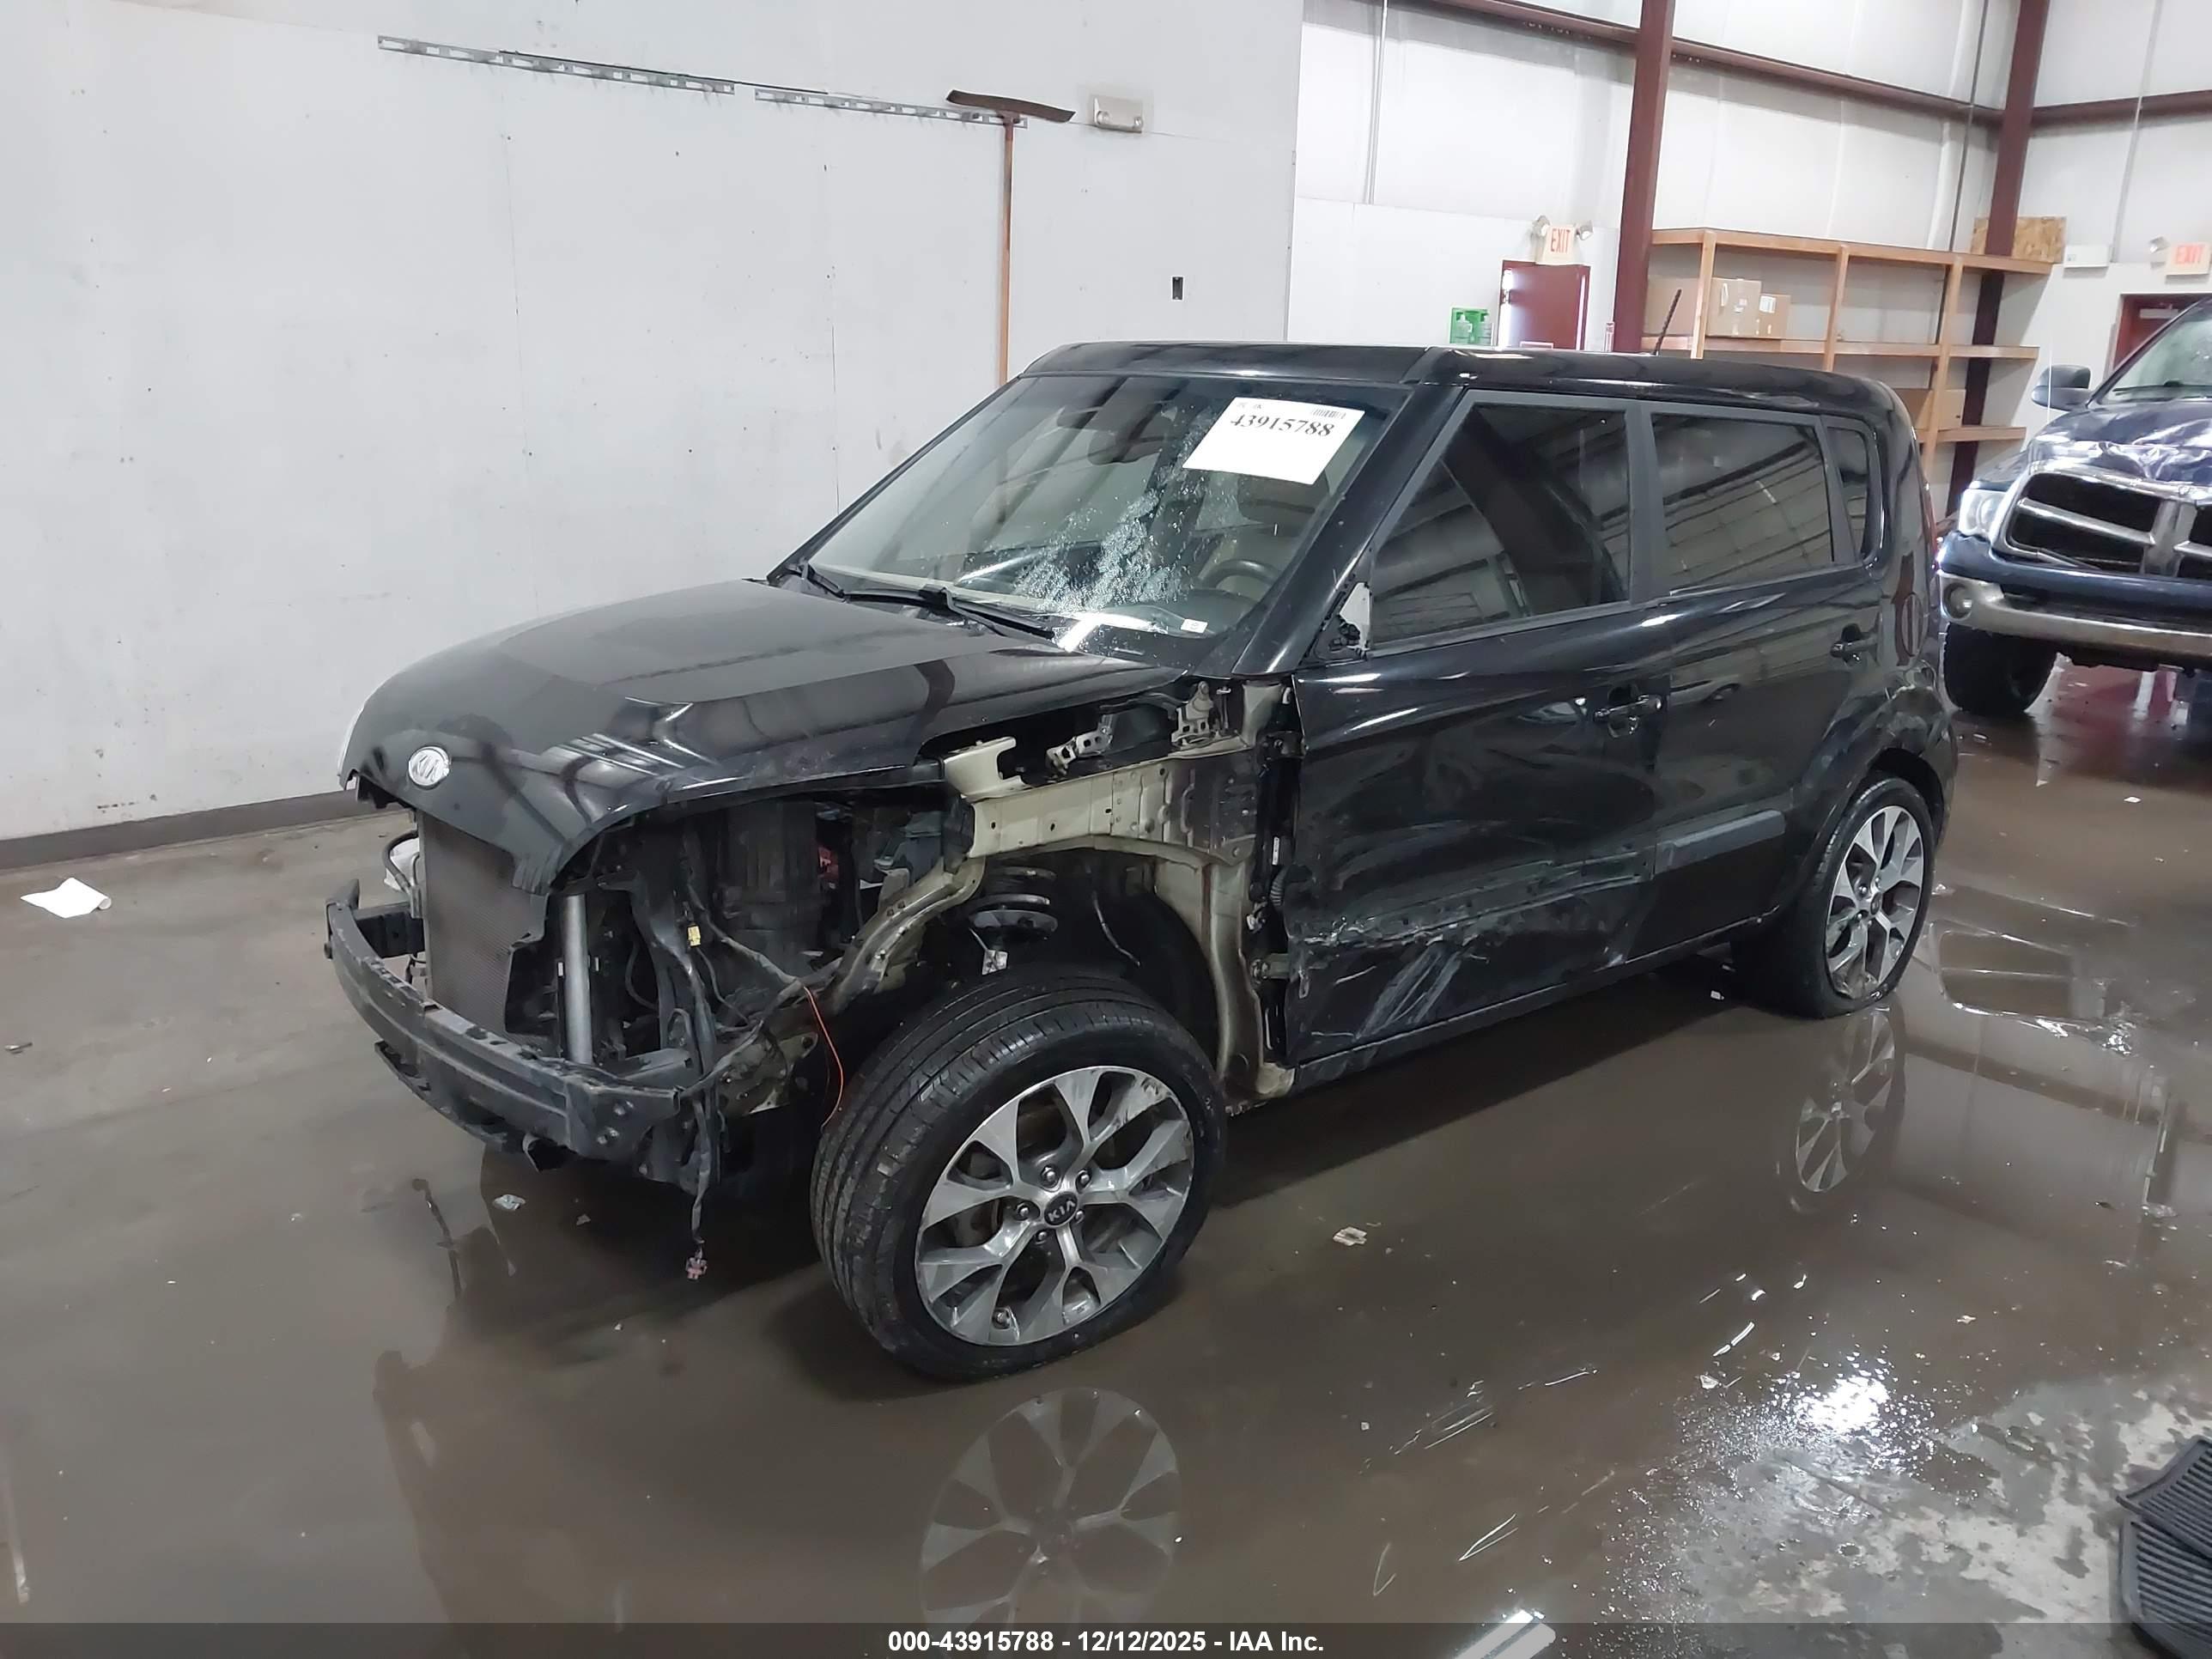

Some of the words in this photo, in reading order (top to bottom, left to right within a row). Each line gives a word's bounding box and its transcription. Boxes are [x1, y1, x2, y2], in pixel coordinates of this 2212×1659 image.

[1551, 228, 1571, 252] EXIT
[2176, 244, 2205, 264] EXIT
[1231, 414, 1335, 436] 43915788
[1048, 1200, 1075, 1221] KIA
